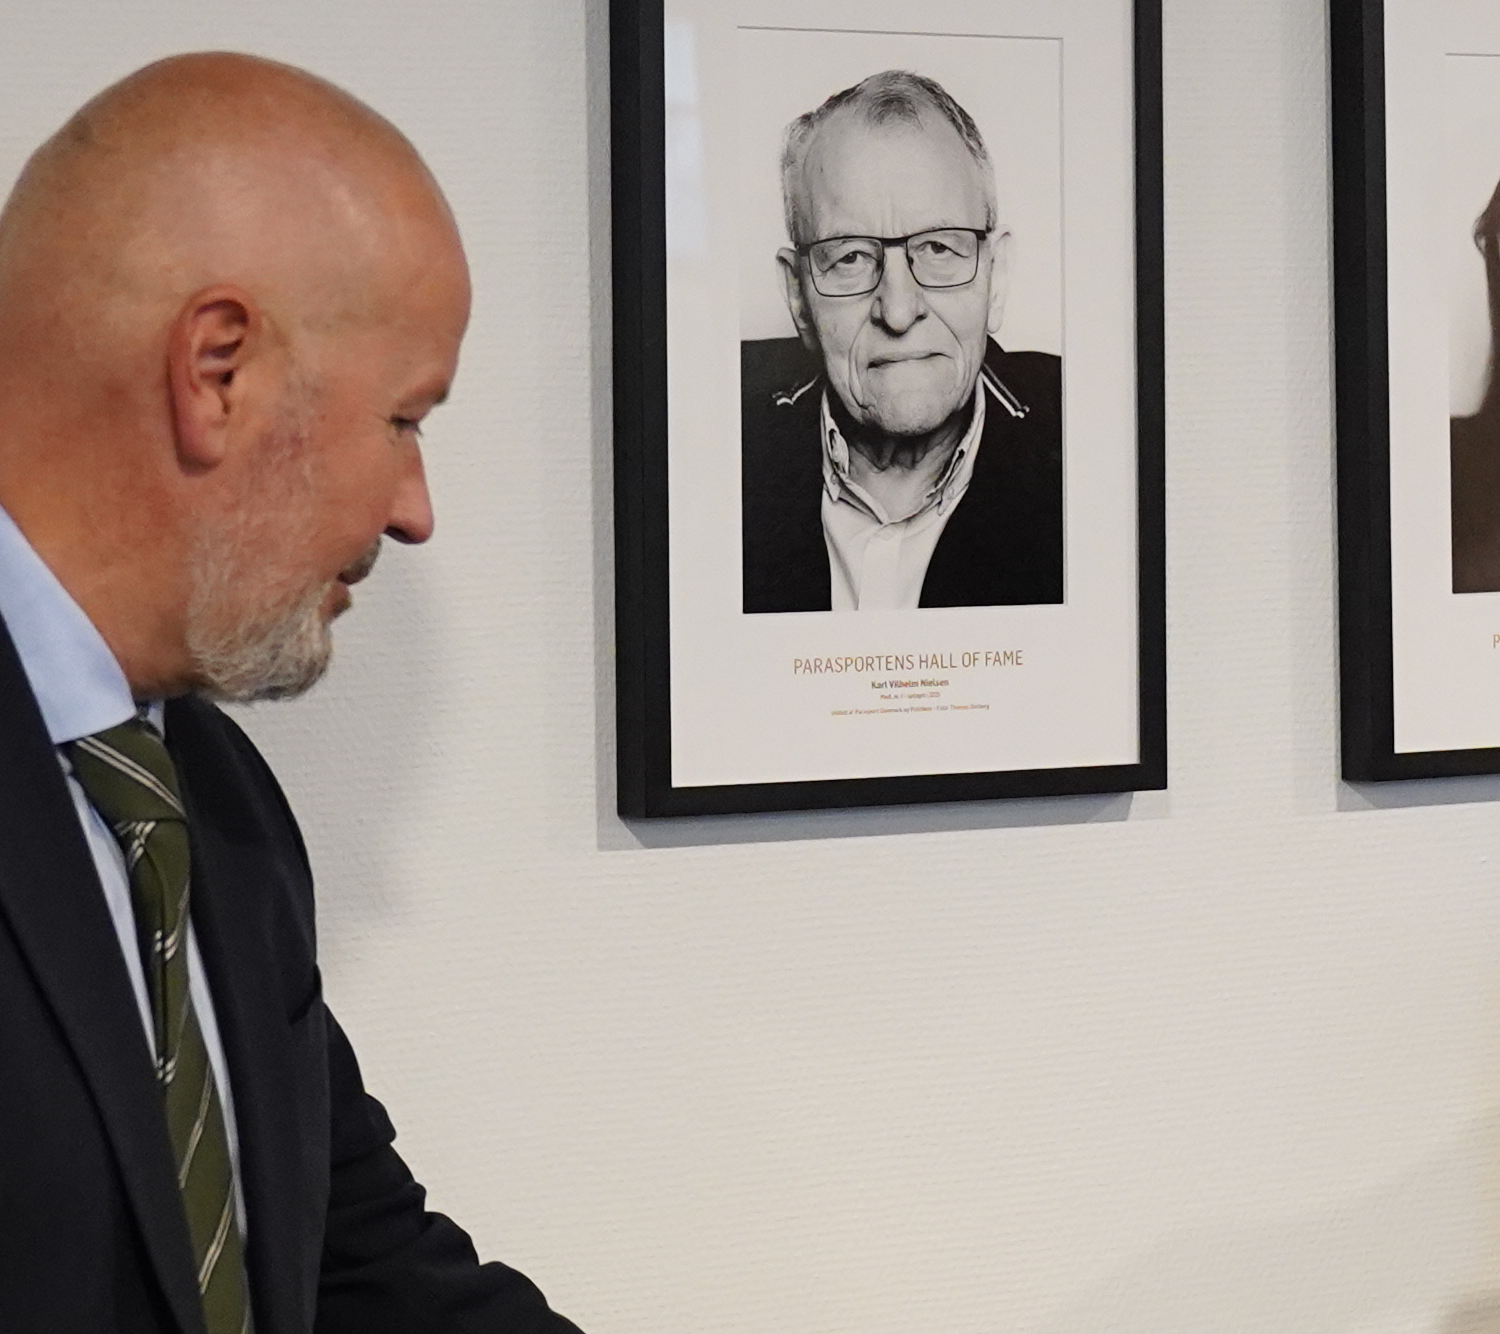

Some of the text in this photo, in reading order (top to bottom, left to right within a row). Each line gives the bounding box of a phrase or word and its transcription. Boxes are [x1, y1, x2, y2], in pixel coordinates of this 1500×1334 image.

[793, 649, 1024, 675] PARASPORTENS HALL OF FAME
[871, 678, 950, 689] Karl Vilhelm Nielsen
